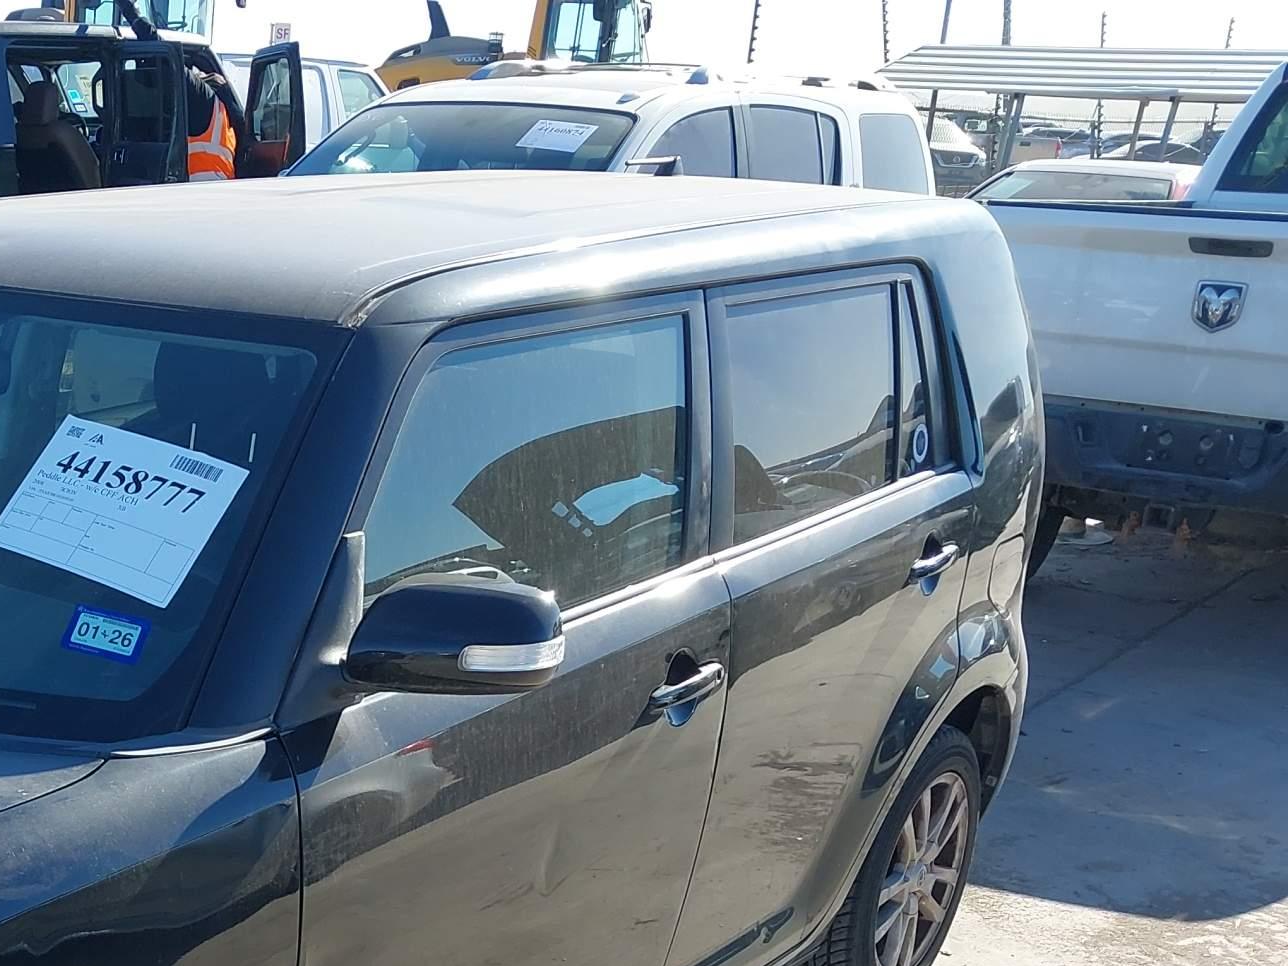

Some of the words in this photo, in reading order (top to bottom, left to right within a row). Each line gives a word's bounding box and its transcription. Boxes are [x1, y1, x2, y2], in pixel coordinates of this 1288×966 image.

[276, 27, 289, 40] SF
[37, 469, 62, 481] Peddle
[60, 476, 81, 487] LLC
[119, 494, 139, 506] ACH
[55, 450, 207, 513] 44158777
